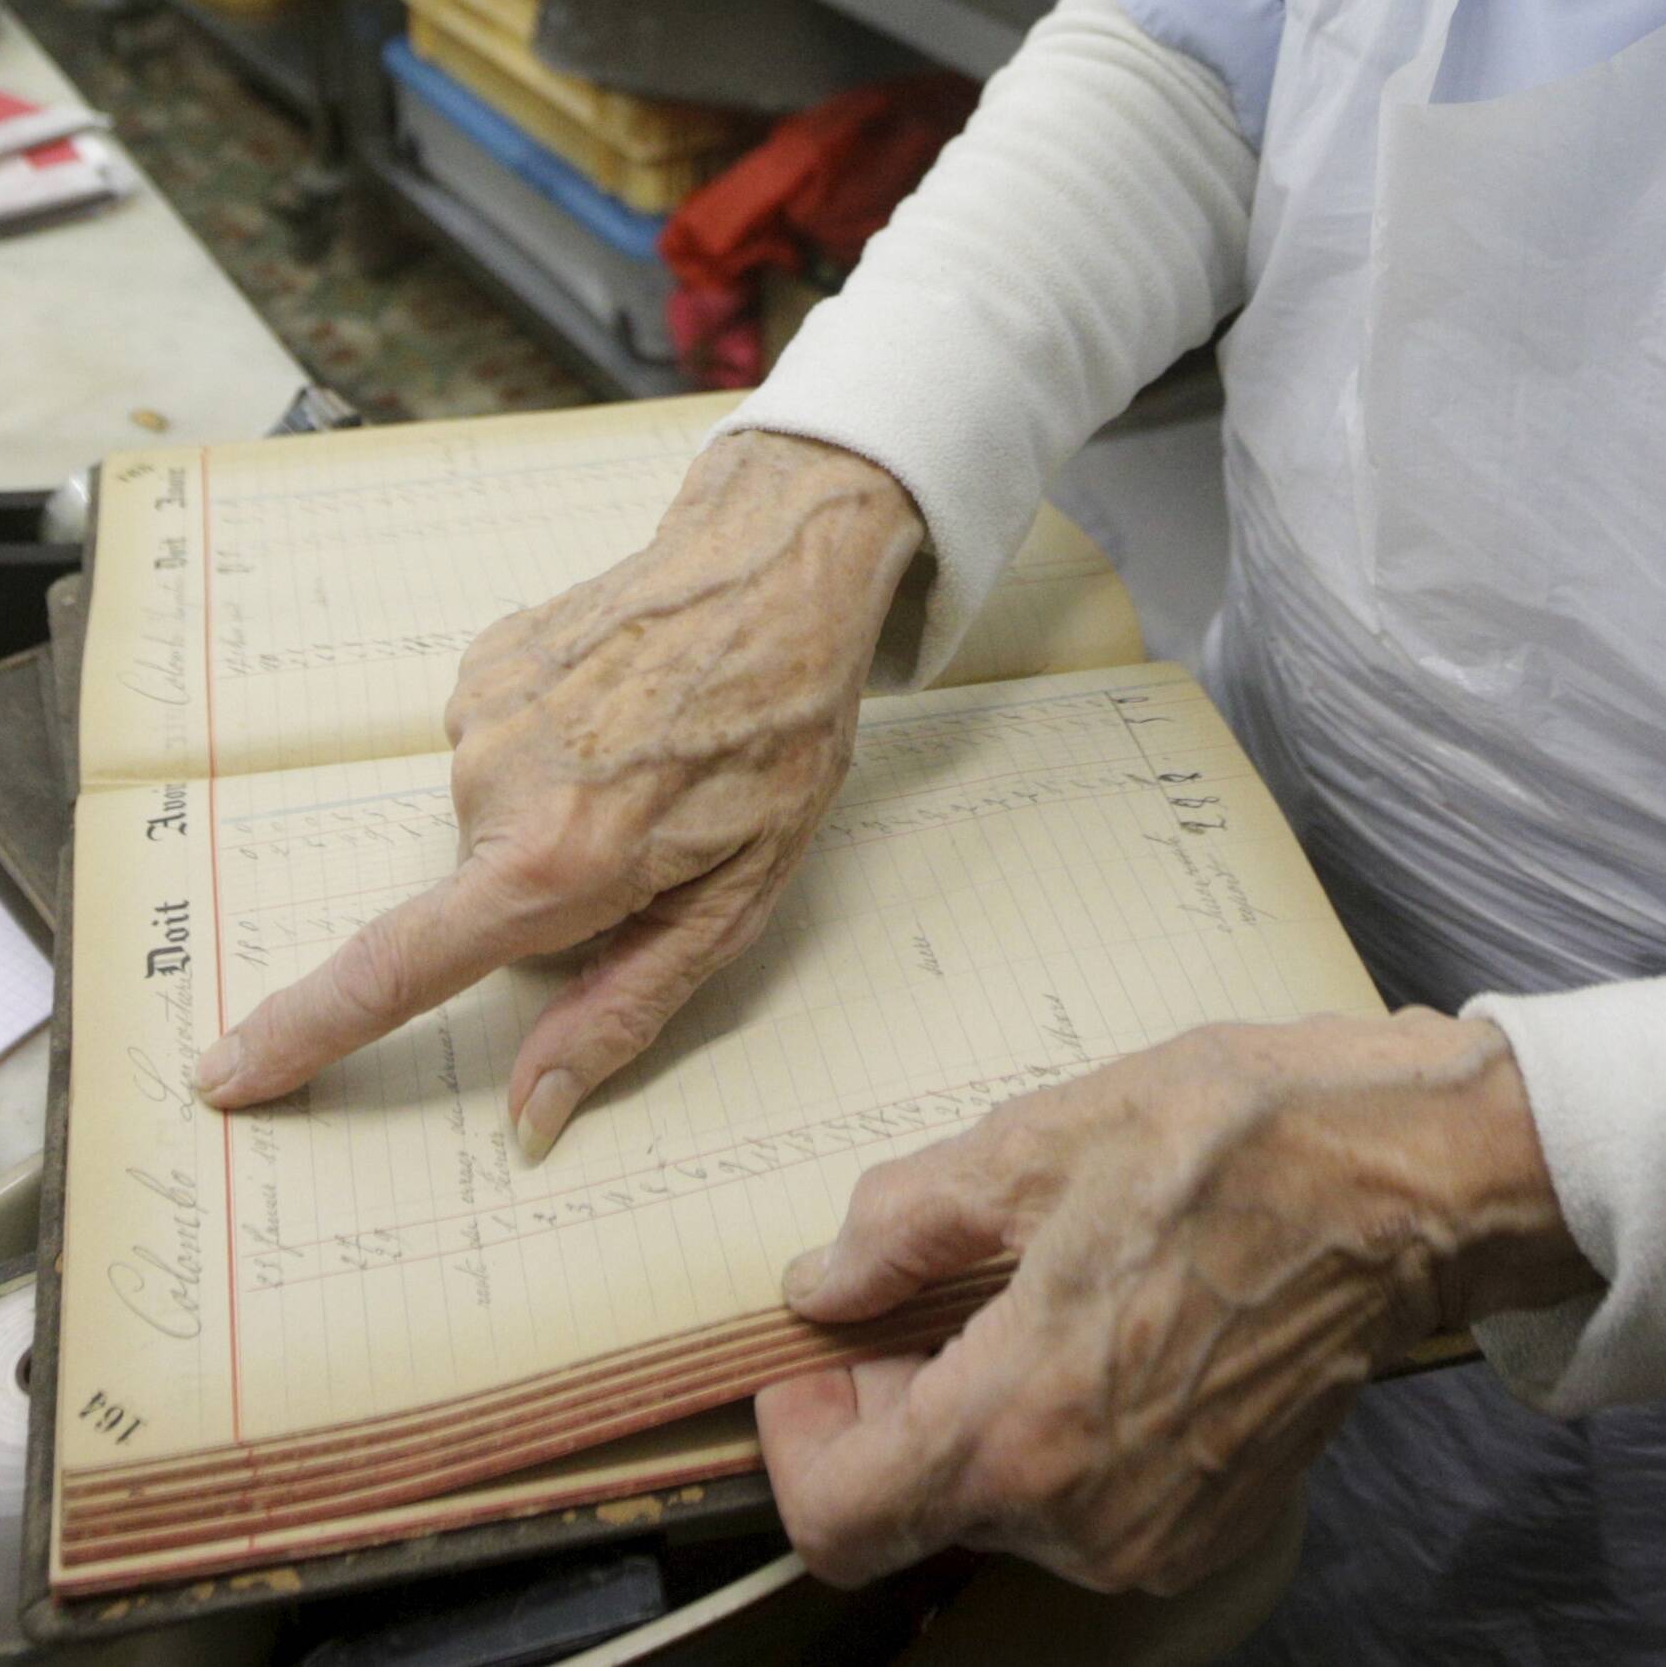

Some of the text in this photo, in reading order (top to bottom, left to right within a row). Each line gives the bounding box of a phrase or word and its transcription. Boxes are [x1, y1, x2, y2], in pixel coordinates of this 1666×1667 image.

[144, 784, 192, 979] Doit Avoi
[106, 1167, 209, 1340] Colombo
[78, 1390, 148, 1446] 164
